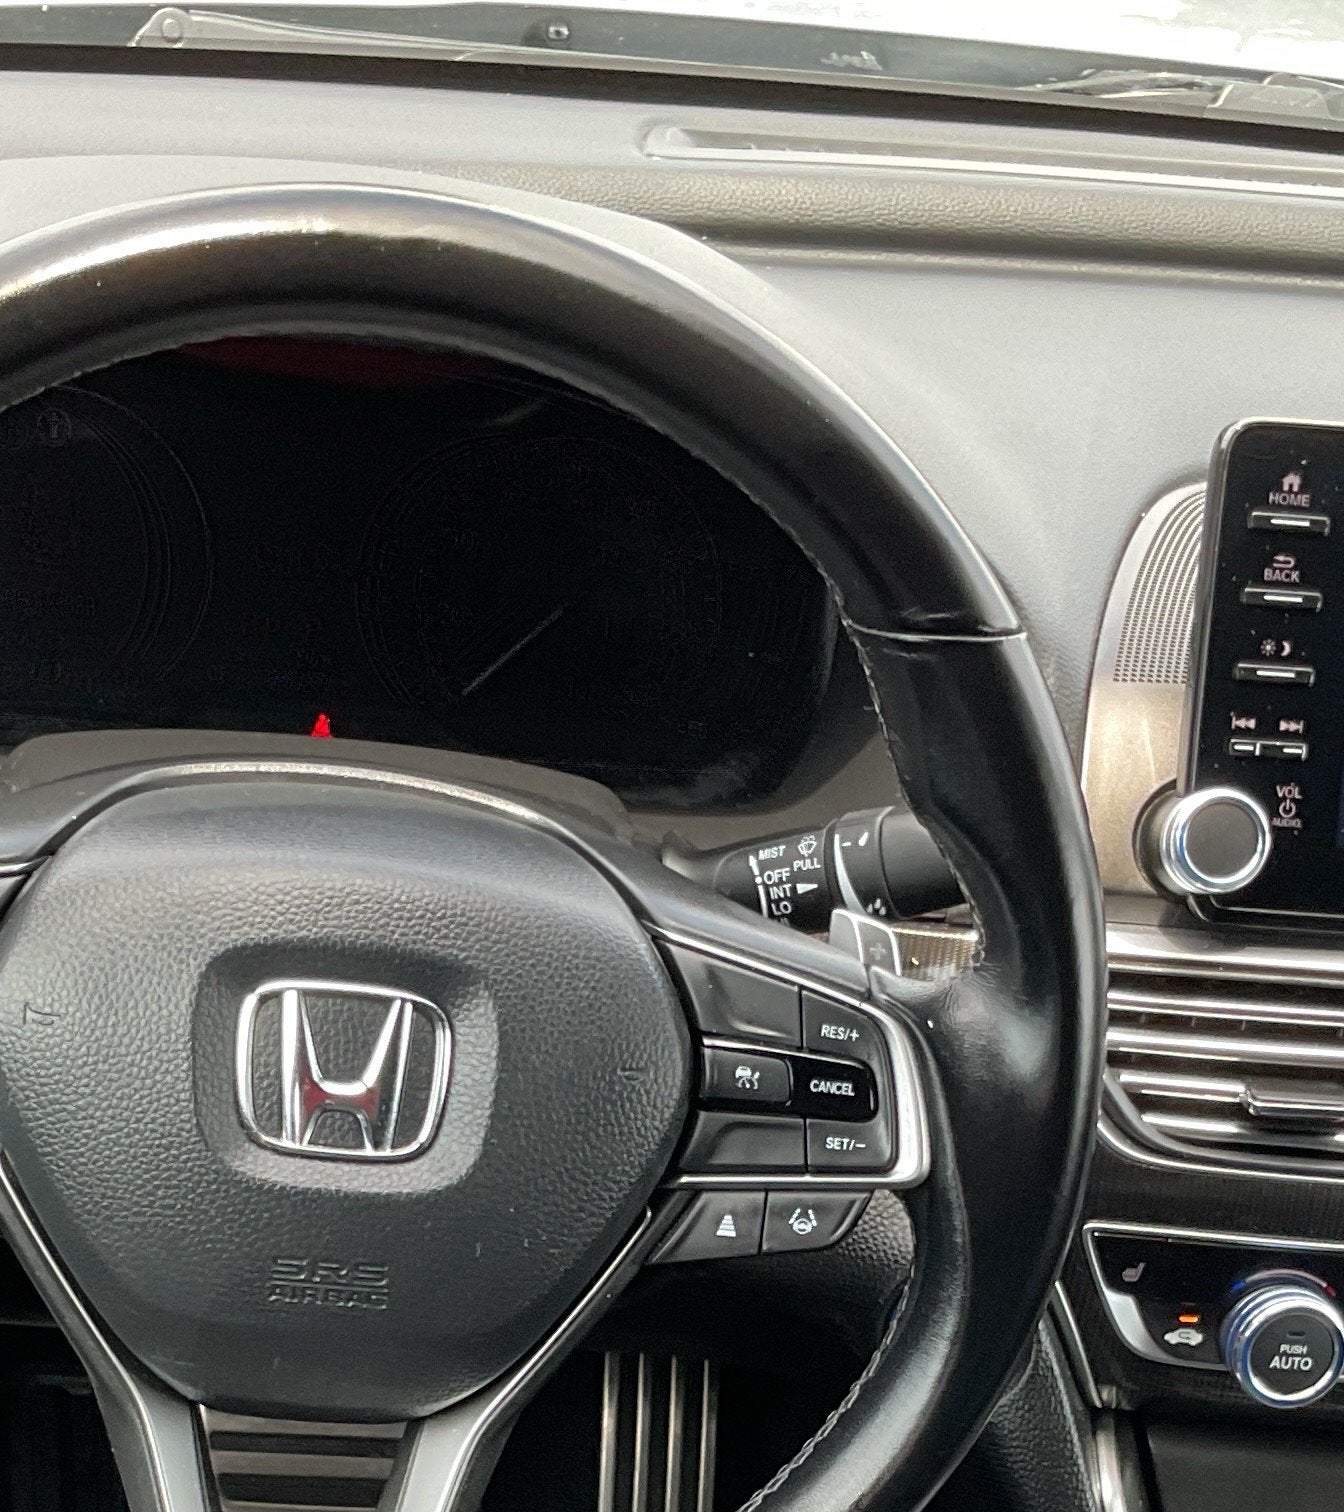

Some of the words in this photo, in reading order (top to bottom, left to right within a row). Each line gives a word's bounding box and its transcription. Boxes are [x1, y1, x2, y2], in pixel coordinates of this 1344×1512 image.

[1268, 491, 1312, 508] HOME
[1263, 567, 1300, 583] BACK
[1276, 785, 1302, 799] VOL
[758, 845, 787, 861] MIST
[793, 857, 822, 873] PULL
[763, 867, 791, 886] OFF
[769, 883, 792, 900] INT
[770, 901, 792, 916] LO
[820, 1023, 861, 1043] RES/+
[809, 1079, 856, 1098] CANCEL
[270, 1257, 390, 1287] SRS
[1280, 1343, 1308, 1355] PUSH
[1269, 1355, 1313, 1372] AUTO
